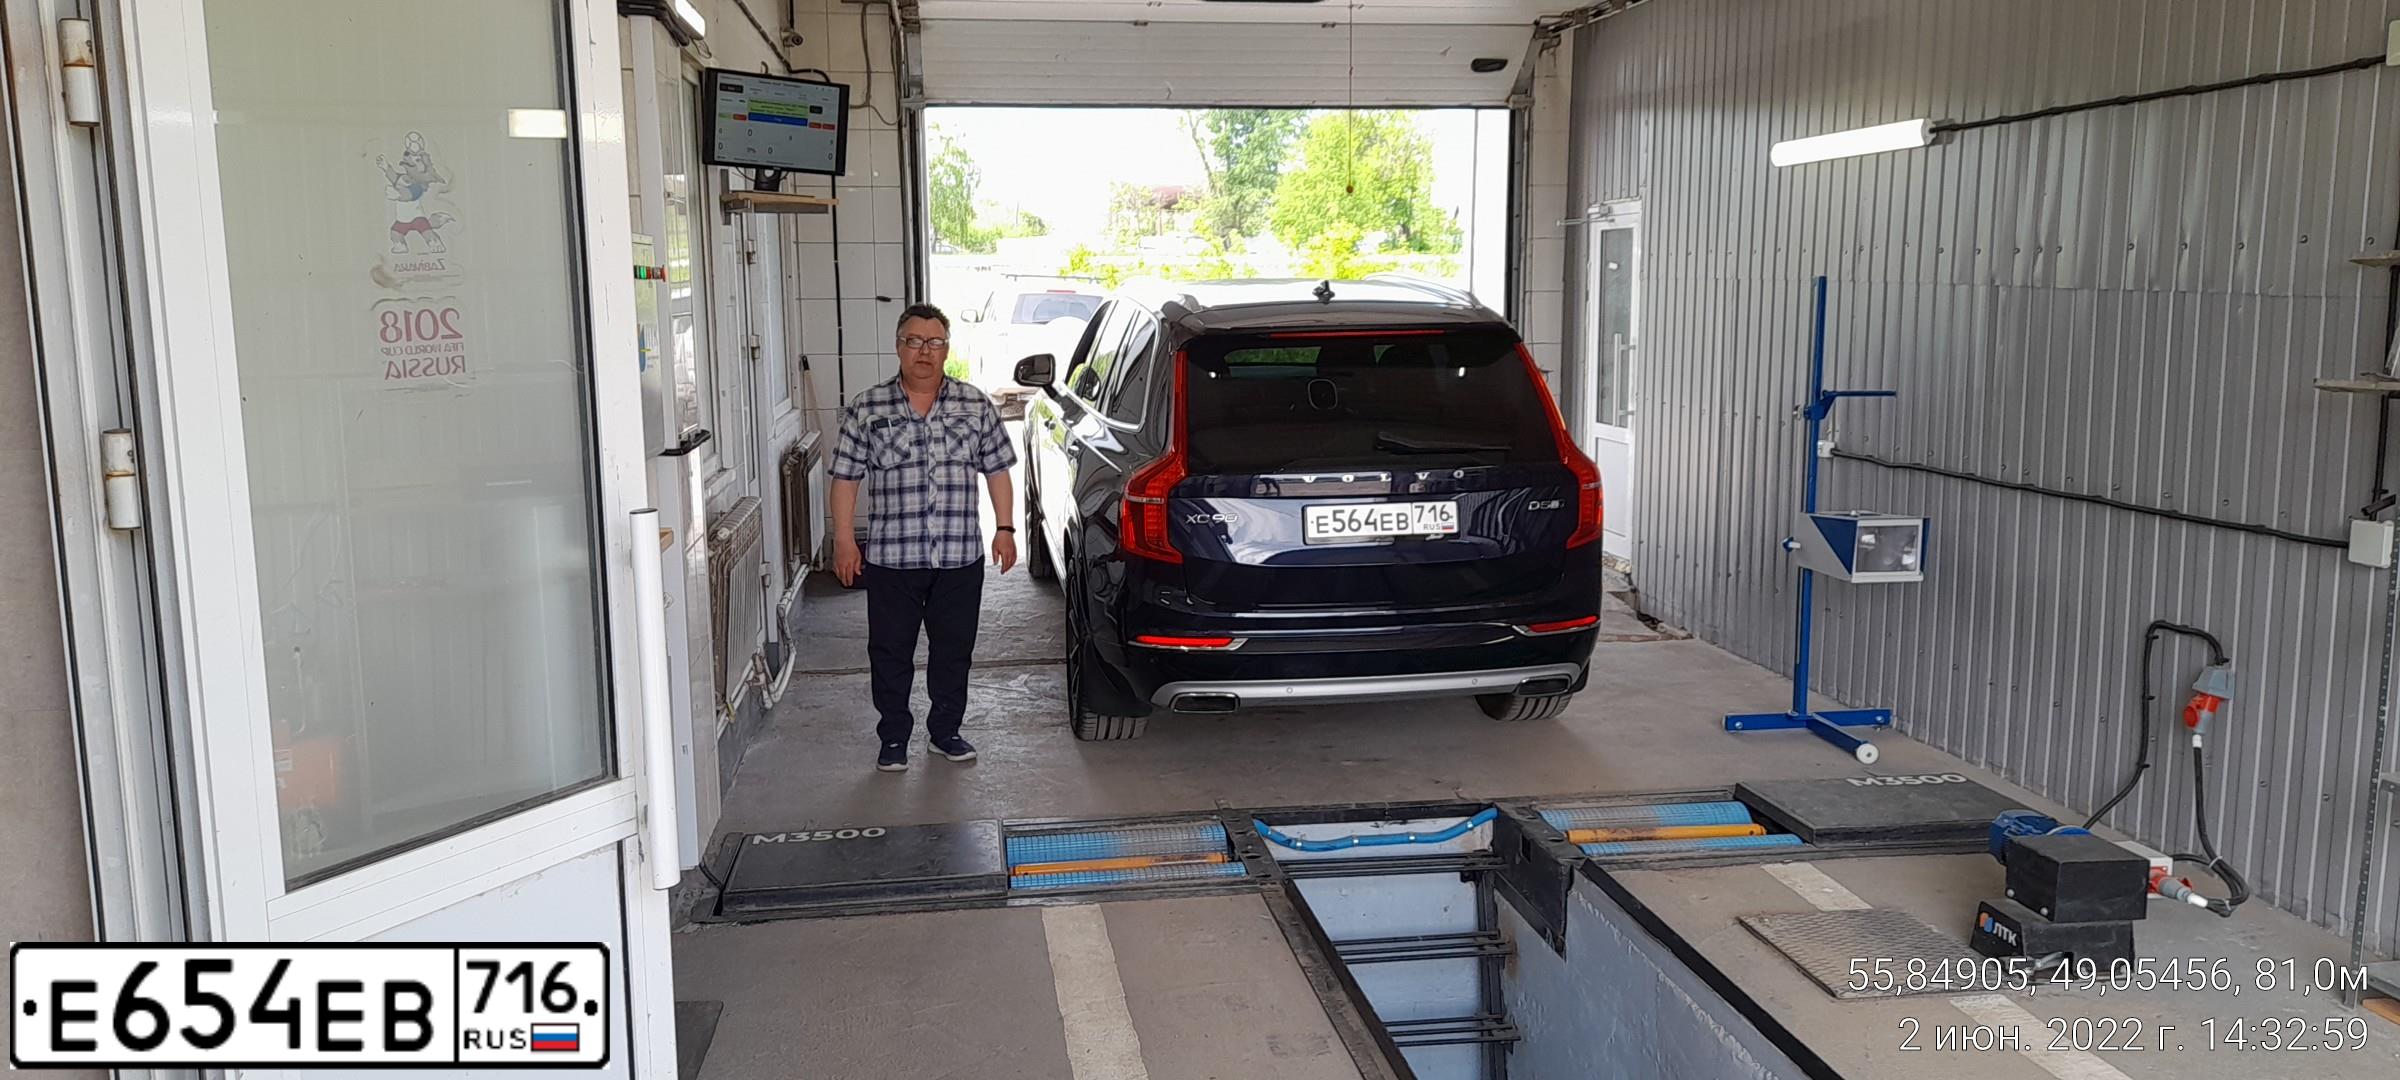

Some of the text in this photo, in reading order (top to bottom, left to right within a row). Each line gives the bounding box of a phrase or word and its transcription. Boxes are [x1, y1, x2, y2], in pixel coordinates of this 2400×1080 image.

[1302, 469, 1465, 483] VOLVO
[1414, 504, 1450, 523] 716
[1423, 523, 1441, 531] RUS
[1846, 774, 1967, 787] M3500
[752, 827, 886, 844] M3500
[1993, 922, 2017, 946] ЛТК
